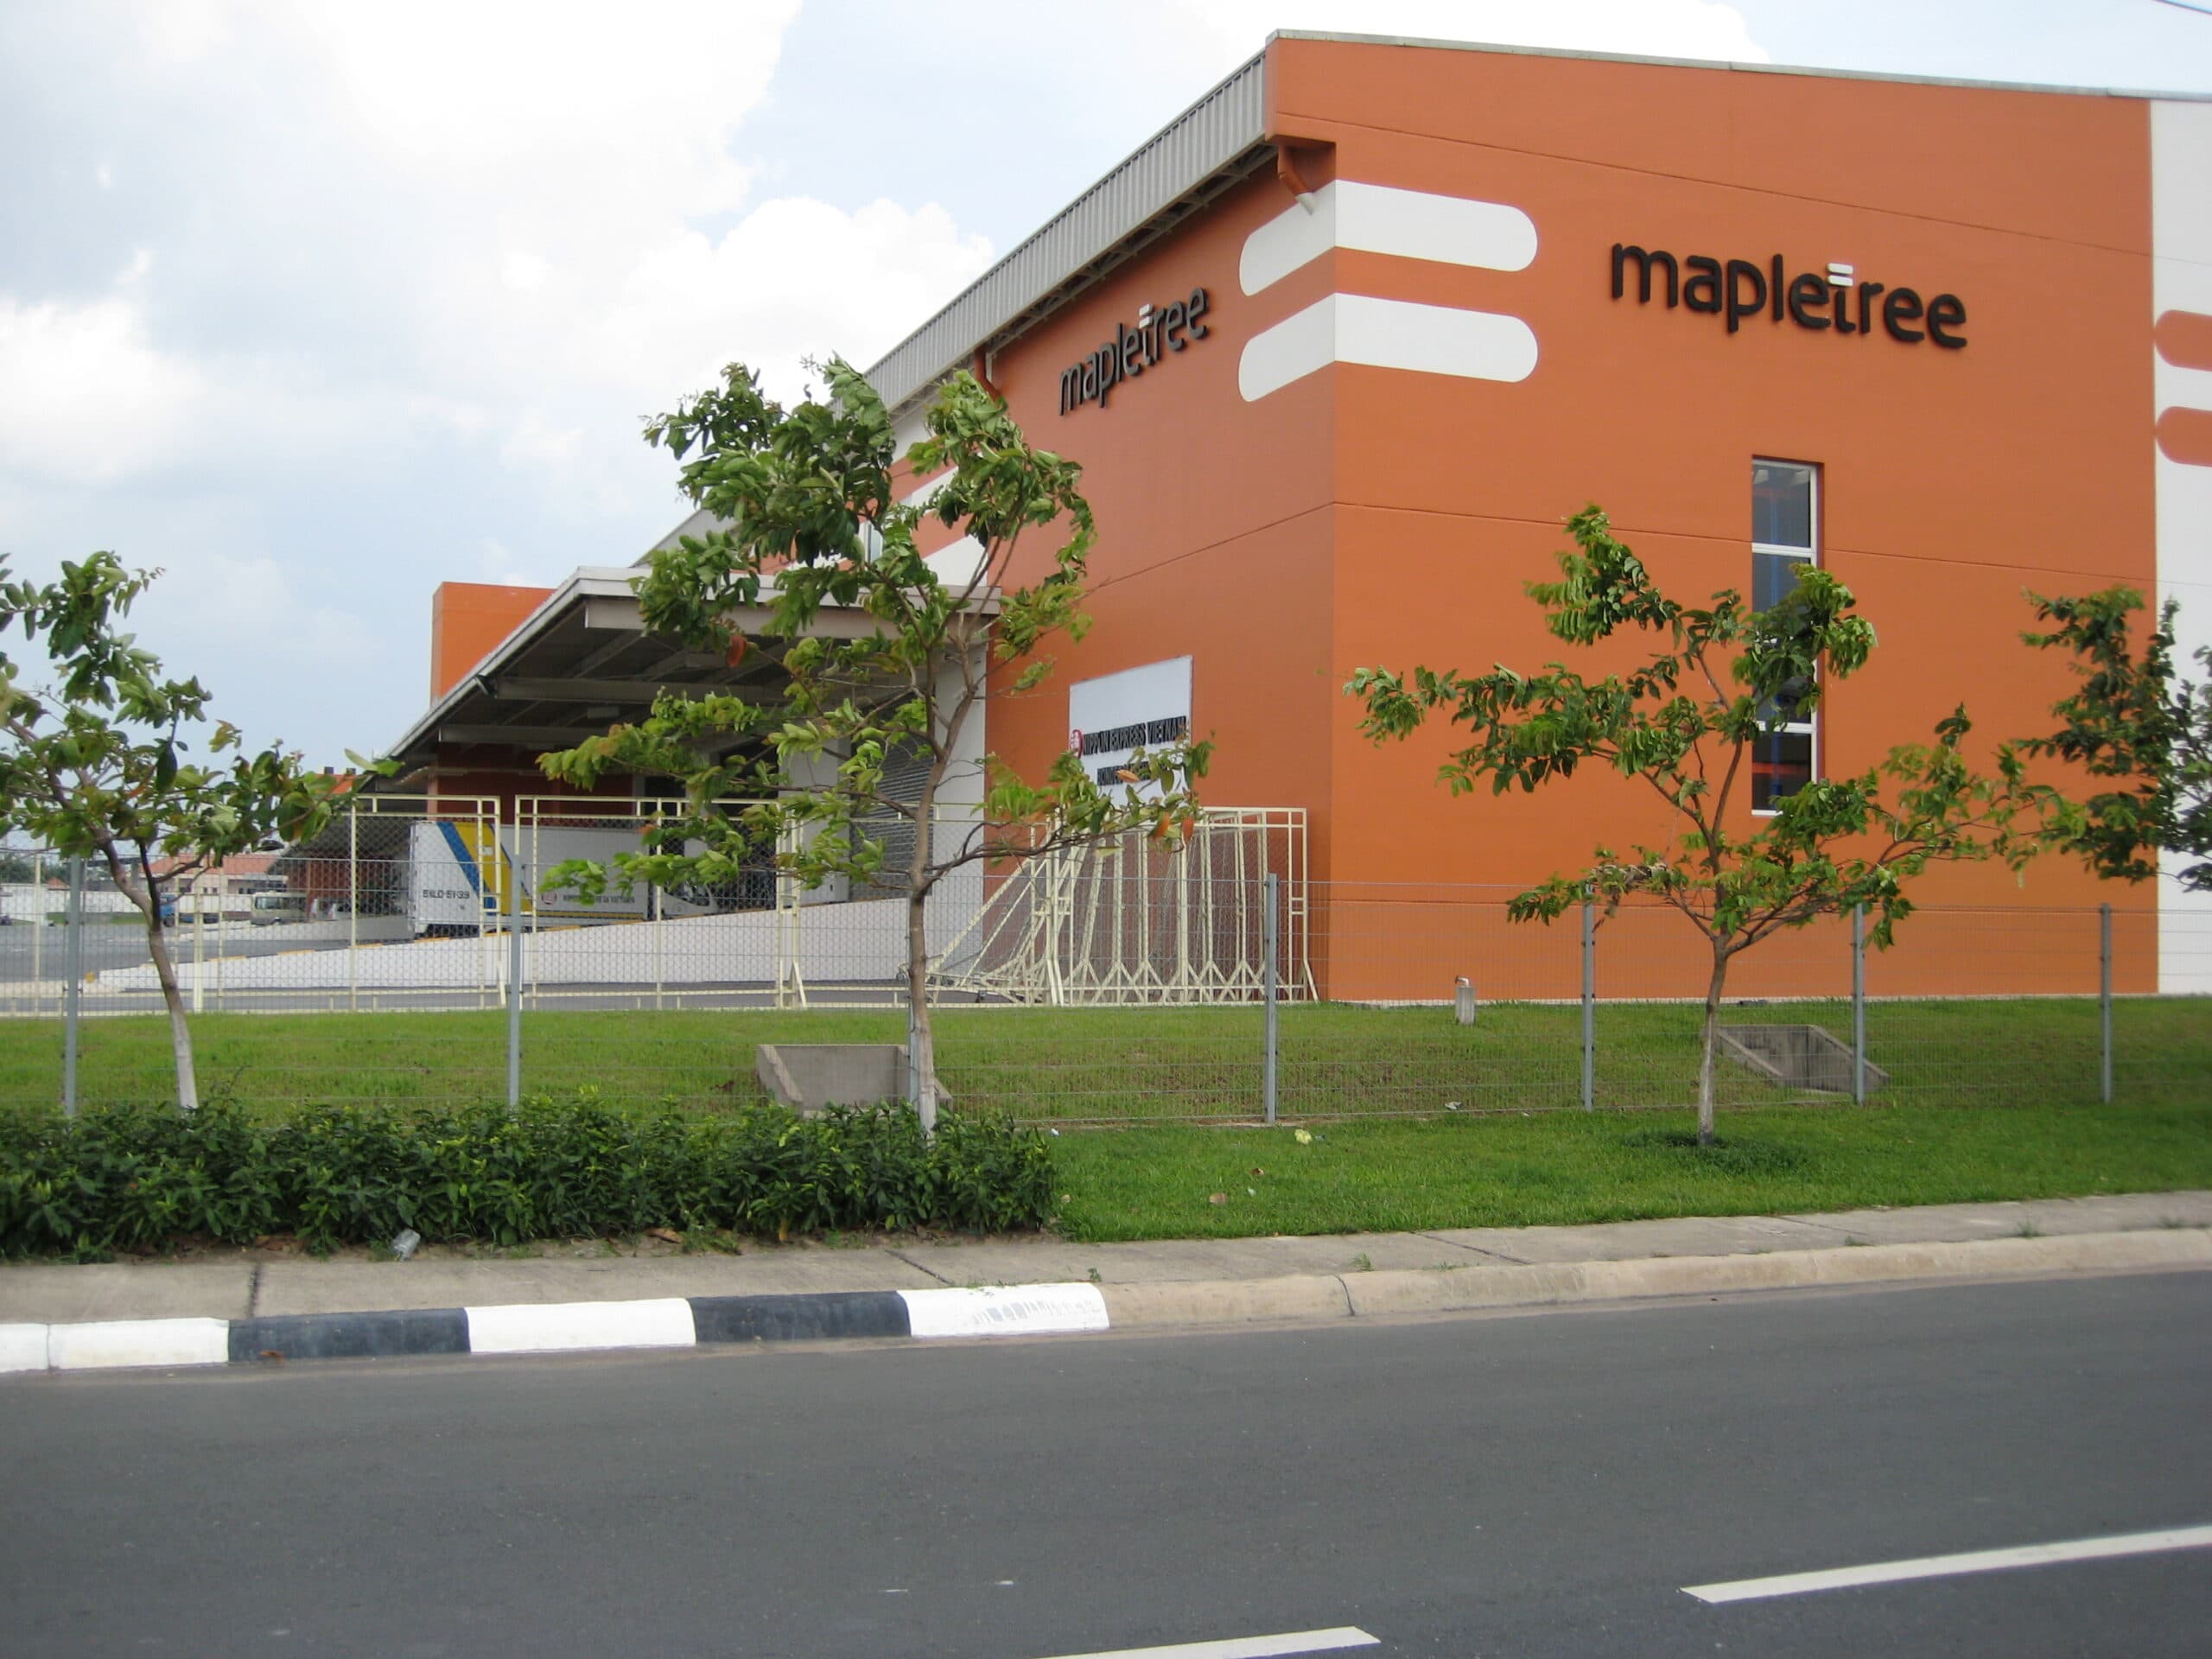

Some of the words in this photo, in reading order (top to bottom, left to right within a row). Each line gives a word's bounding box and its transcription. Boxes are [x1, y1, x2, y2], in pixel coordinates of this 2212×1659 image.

[1611, 243, 1967, 348] mapletree
[1058, 287, 1208, 416] mapletree
[1083, 730, 1109, 756] NIPPON
[1109, 722, 1147, 751] EXPRESS
[1147, 715, 1186, 744] VIETNAM
